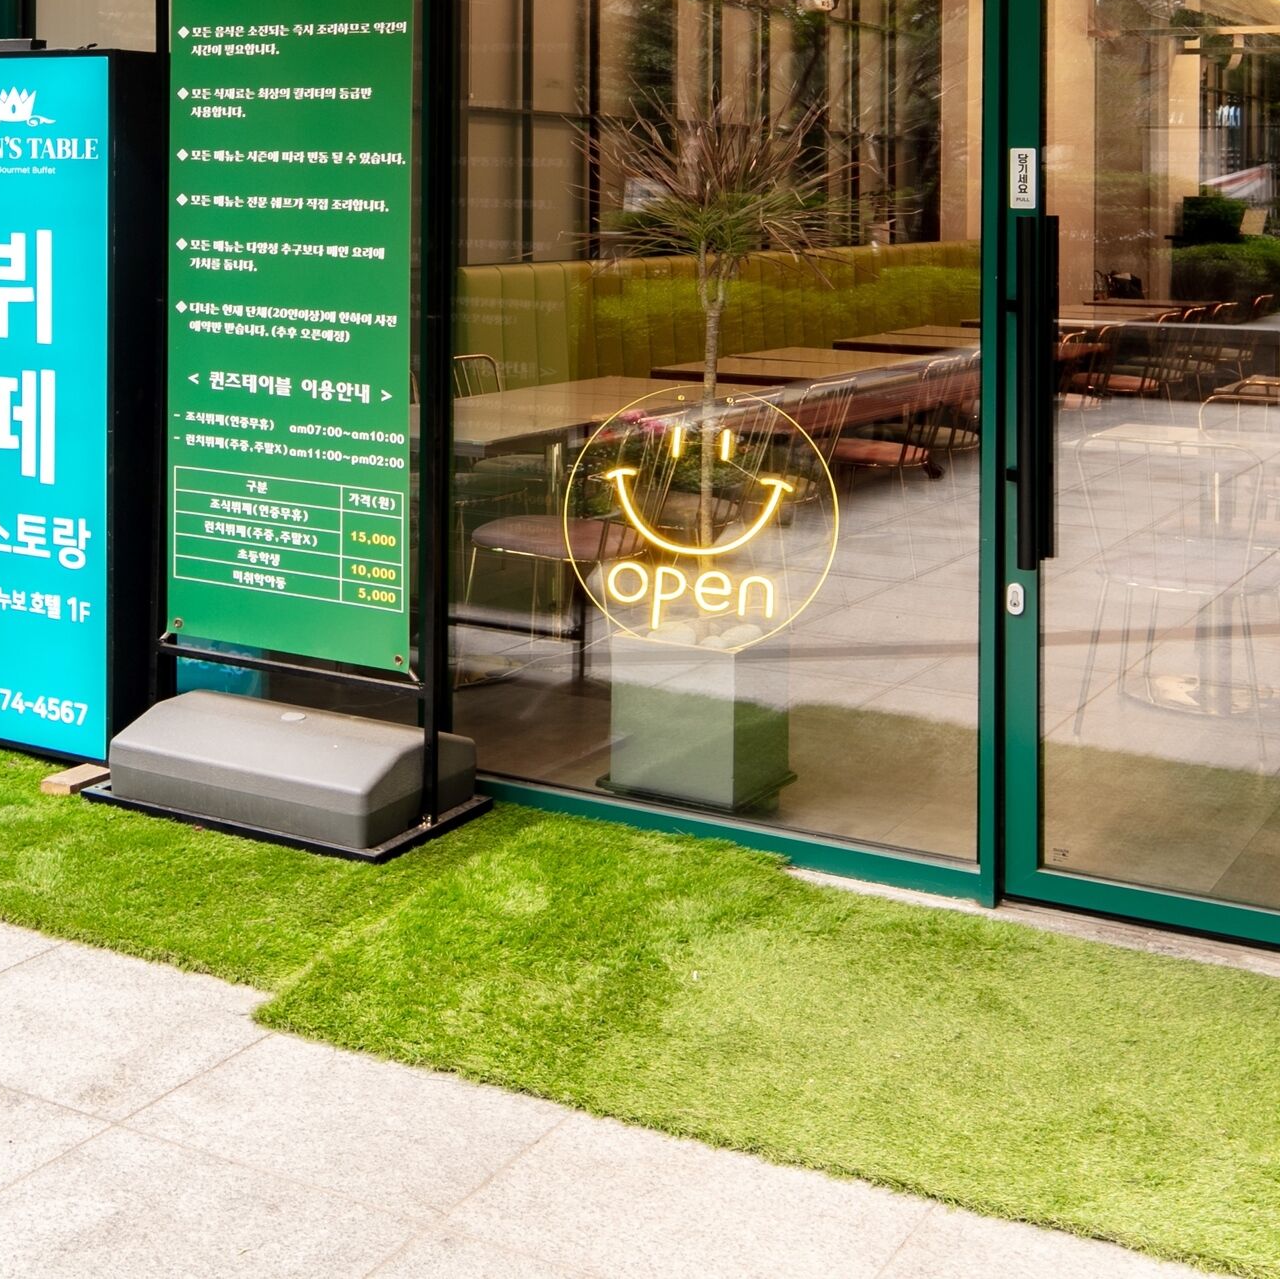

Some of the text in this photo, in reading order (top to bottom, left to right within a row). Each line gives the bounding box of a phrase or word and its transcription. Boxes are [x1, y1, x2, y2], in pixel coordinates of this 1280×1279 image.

[192, 26, 211, 38] 모든
[215, 25, 245, 37] 음식은
[293, 24, 314, 36] 즉시
[316, 22, 371, 35] 조리하므로
[374, 21, 407, 34] 약간의
[191, 44, 221, 56] 시간이
[192, 88, 211, 99] 모든
[258, 87, 290, 100] 최상의
[191, 106, 246, 118] 사용합니다.
[26, 137, 99, 160] TABLE
[191, 150, 211, 161] 모든
[214, 150, 244, 162] 메뉴는
[247, 150, 279, 163] 시즌에
[282, 151, 304, 163] 따라
[346, 152, 356, 164] 수
[360, 152, 406, 165] 있습니다.
[32, 166, 56, 175] Buffet
[1017, 153, 1029, 194] 당기세요
[190, 195, 211, 206] 모든
[213, 195, 244, 207] 메뉴는
[331, 199, 389, 213] 조리합니다.
[190, 240, 211, 251] 모든
[213, 240, 244, 253] 메뉴는
[246, 241, 278, 255] 다양성
[190, 257, 221, 271] 가치를
[374, 314, 398, 327] 사전
[209, 371, 370, 404] 퀸즈테이블 이용안내
[289, 424, 405, 445] am07:00~am10:00
[246, 480, 396, 511] 구분 가격(원)
[350, 530, 396, 547] 15,000
[237, 548, 396, 580] 초등학생 10,000
[232, 570, 396, 603] 미취학아동 5,000
[607, 561, 775, 629] open
[29, 591, 61, 620] 호텔
[67, 596, 91, 623] 1F
